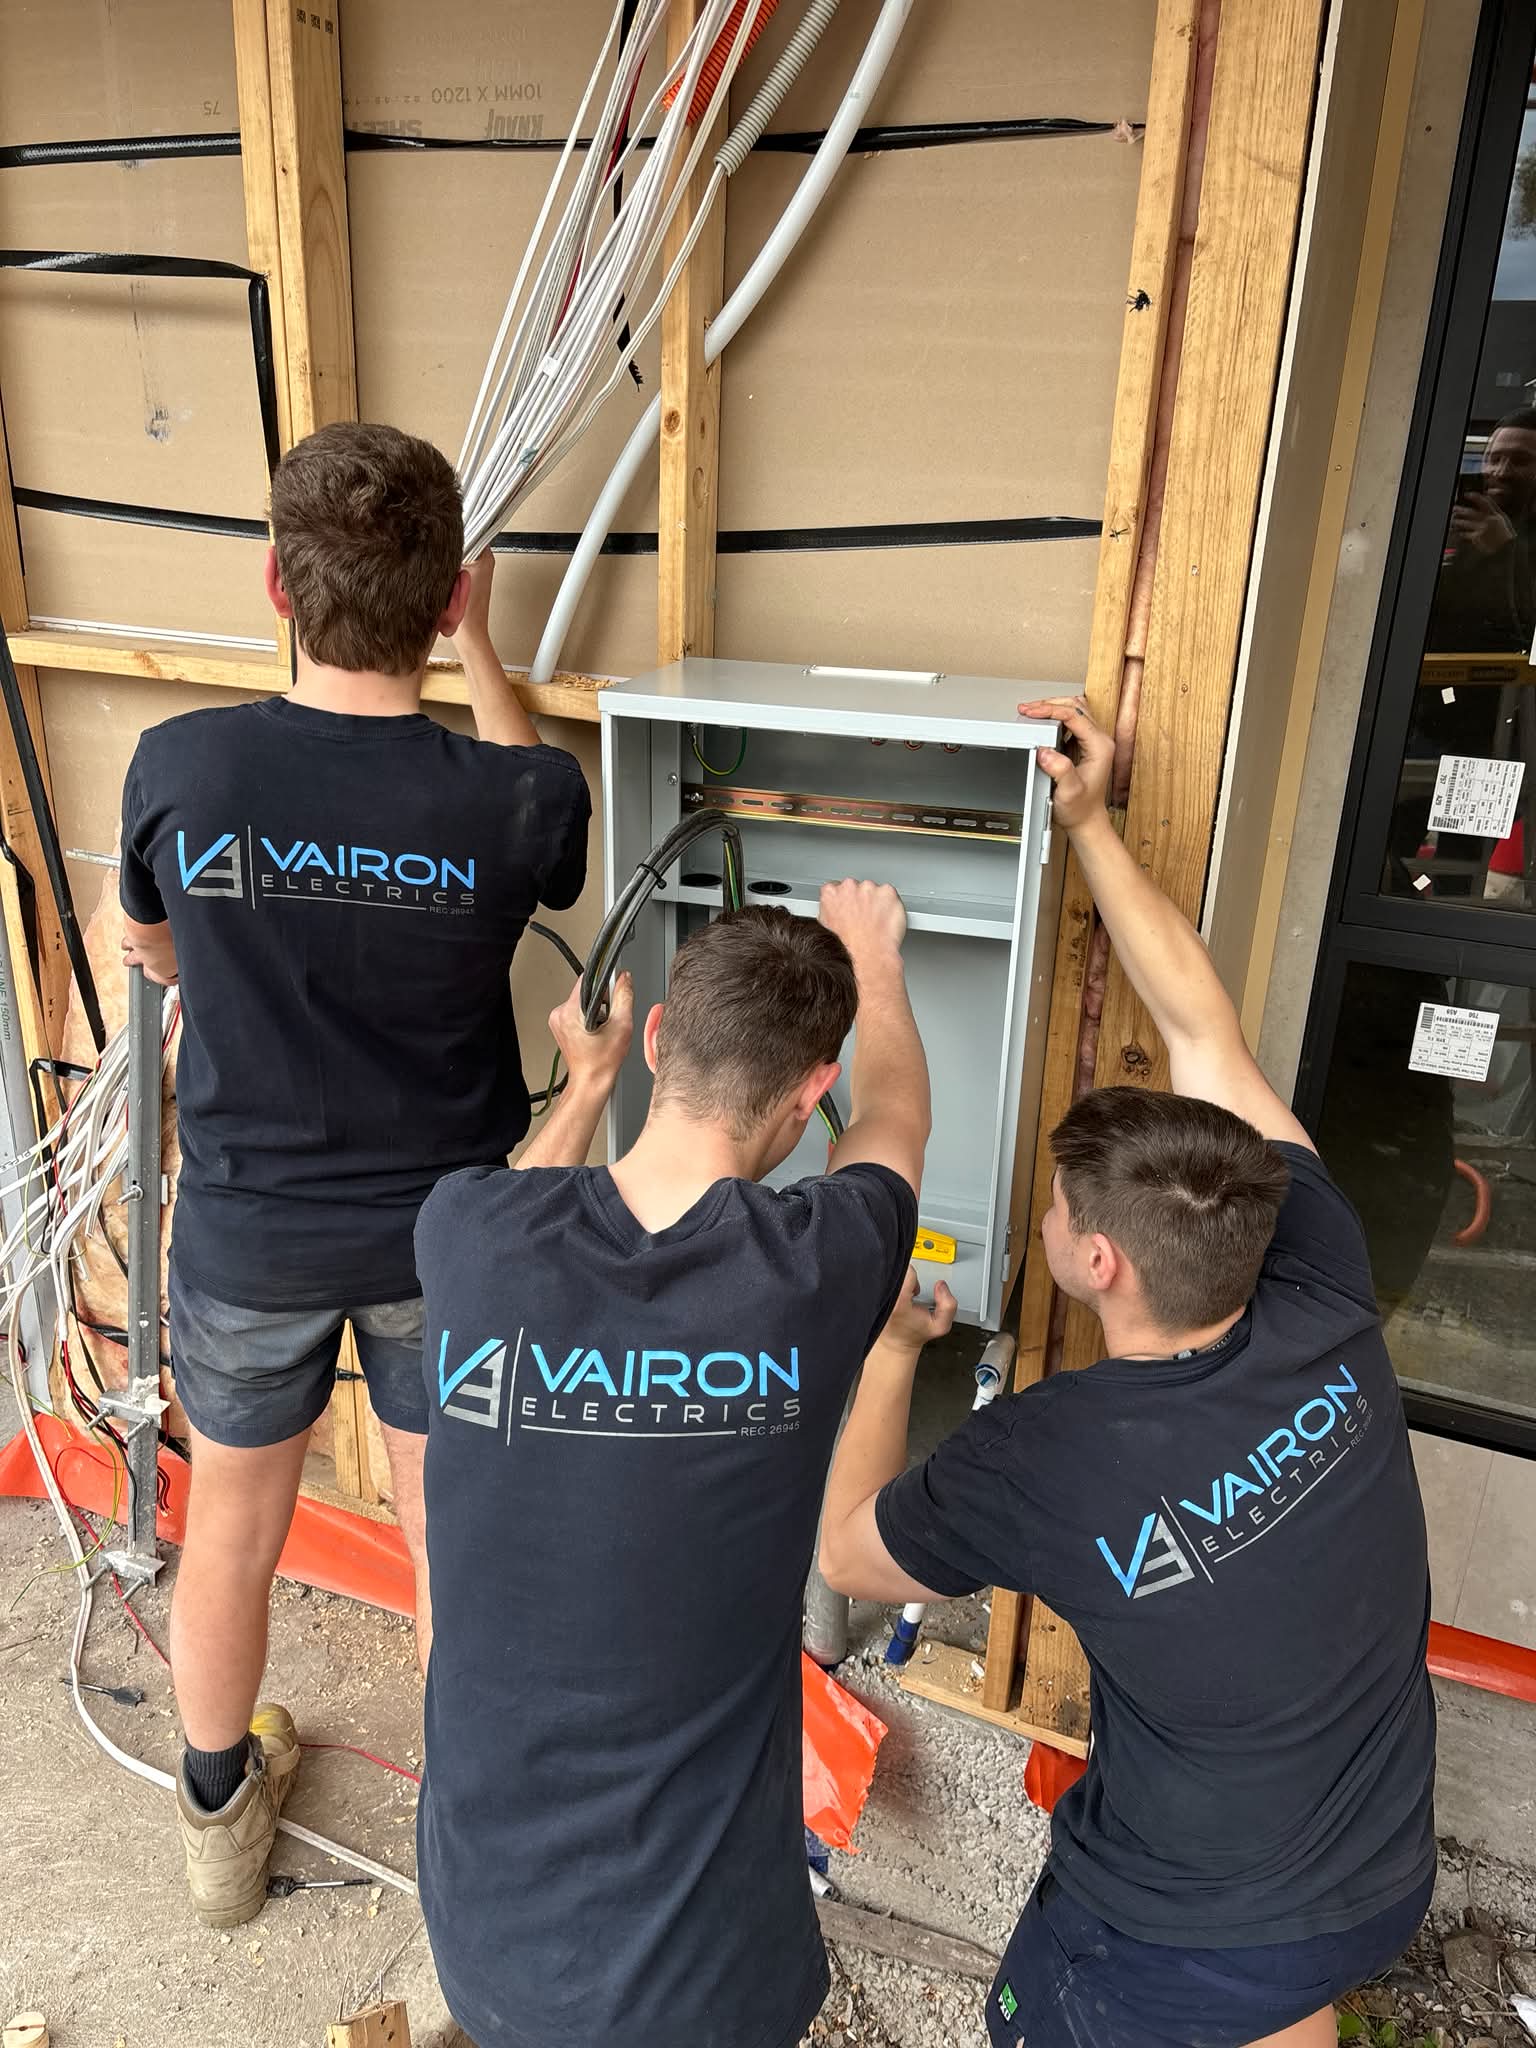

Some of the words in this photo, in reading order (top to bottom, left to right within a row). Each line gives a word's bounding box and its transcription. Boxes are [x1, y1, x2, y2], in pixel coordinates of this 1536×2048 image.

[431, 87, 471, 104] 1200
[477, 86, 489, 103] X
[494, 83, 543, 101] 10MM
[203, 100, 222, 116] 75
[260, 837, 475, 890] VAIRON
[262, 874, 475, 905] ELECTRICS
[530, 1344, 800, 1398] VAIRON
[521, 1397, 801, 1424] ELECTRICS
[740, 1426, 767, 1437] REC
[769, 1420, 801, 1435] 26945
[1178, 1363, 1358, 1526] VAIRON
[1200, 1394, 1369, 1554] ELECTRICS
